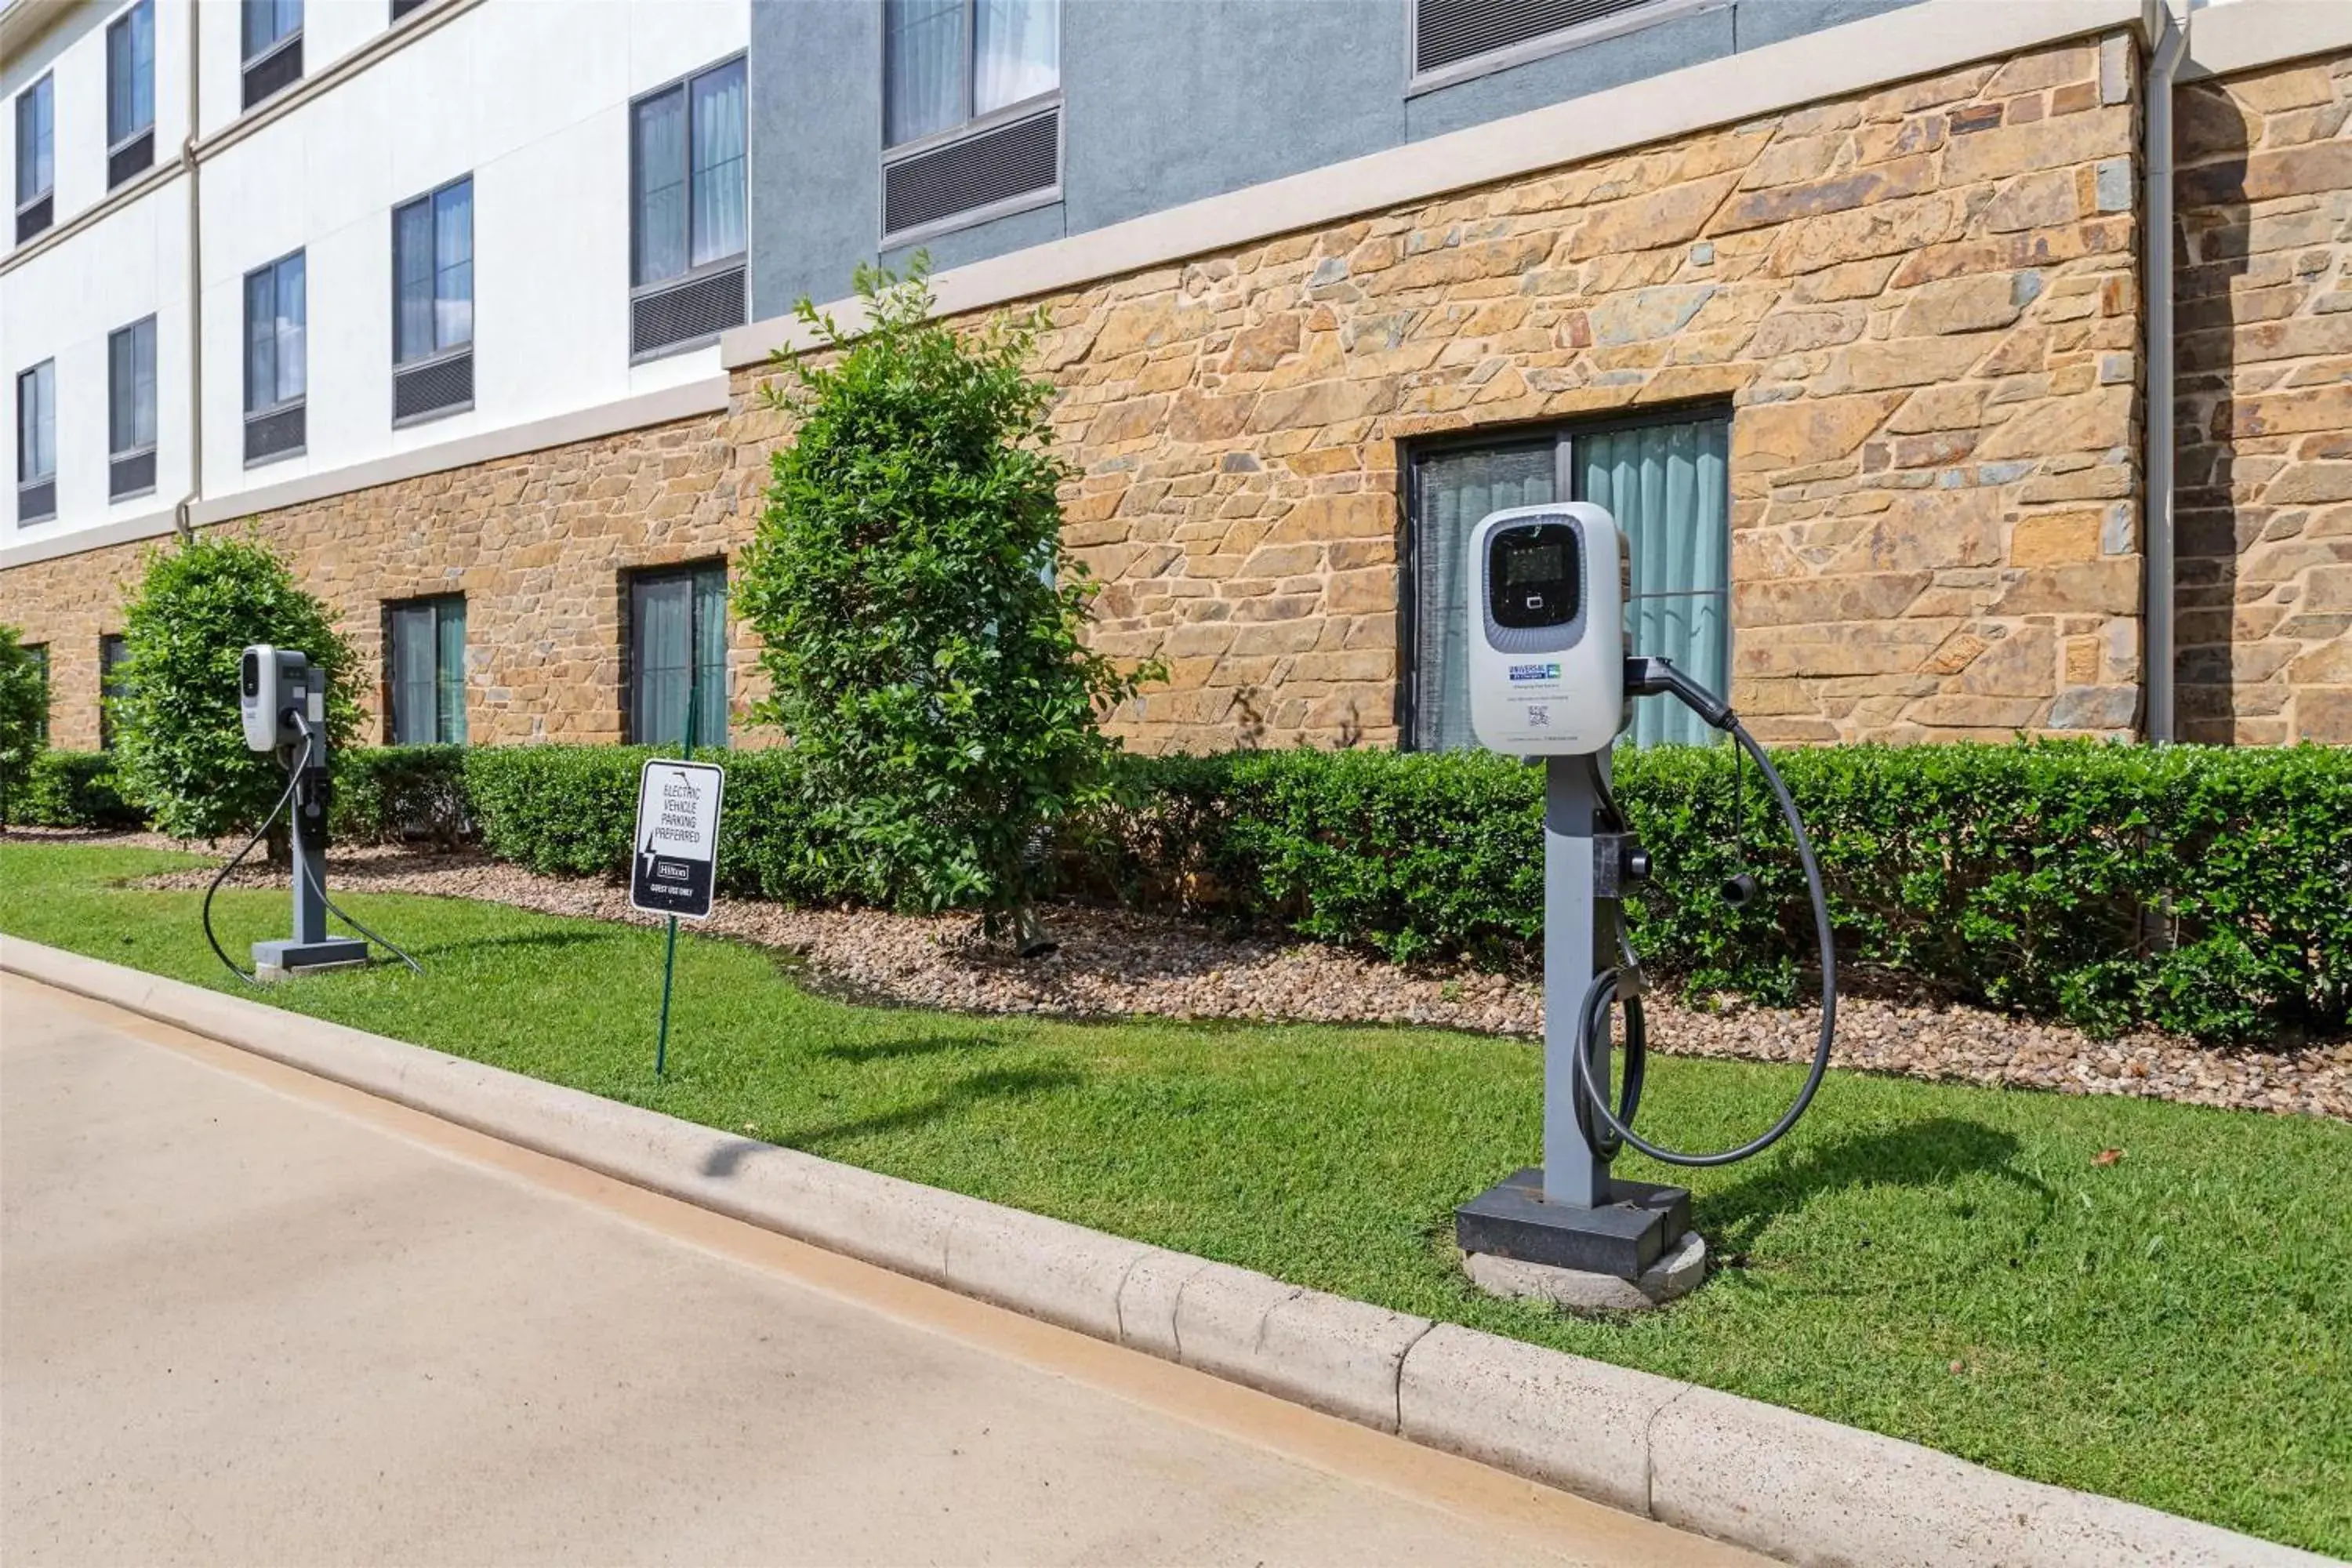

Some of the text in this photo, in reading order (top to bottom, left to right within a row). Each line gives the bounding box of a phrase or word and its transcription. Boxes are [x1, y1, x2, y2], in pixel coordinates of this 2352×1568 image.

[663, 784, 701, 800] ELECTRIC
[664, 799, 697, 815] VEHICLE
[661, 812, 697, 828] PARKING
[655, 827, 700, 843] PREFERRED
[660, 865, 686, 877] Hilton
[650, 884, 693, 897] GUEST USE ONLY
